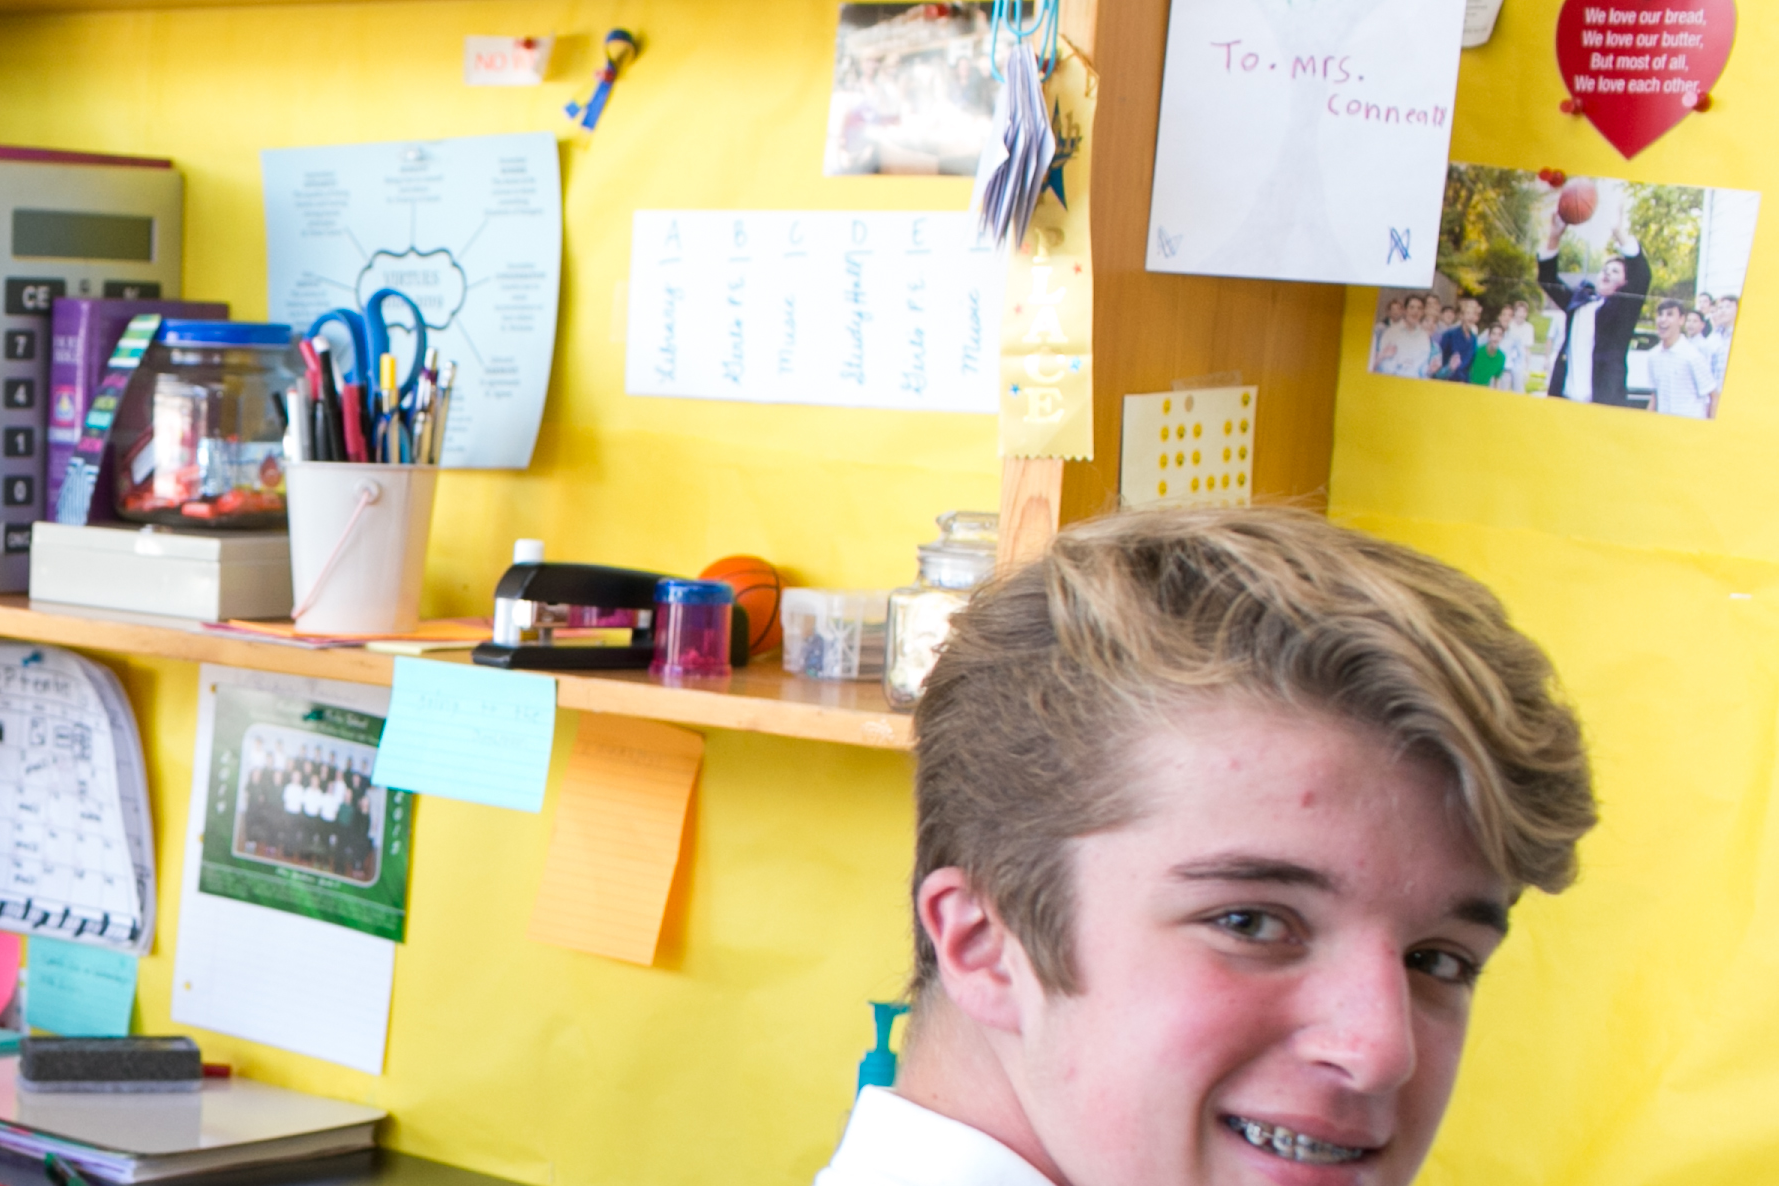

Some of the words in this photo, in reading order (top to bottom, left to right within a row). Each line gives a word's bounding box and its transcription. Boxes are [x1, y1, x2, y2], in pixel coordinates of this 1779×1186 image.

[1584, 7, 1606, 25] We
[1608, 7, 1636, 25] love
[1639, 11, 1662, 25] our
[1665, 8, 1707, 26] bread,
[1581, 30, 1604, 47] We
[1605, 30, 1633, 47] love
[1636, 33, 1660, 47] our
[1661, 31, 1704, 49] butter,
[1590, 52, 1614, 70] But
[1616, 54, 1650, 70] most
[1652, 53, 1667, 70] of
[1669, 54, 1689, 72] all,
[1574, 75, 1596, 93] We
[1597, 75, 1625, 93] love
[1627, 76, 1661, 93] each
[665, 218, 682, 250] A
[733, 218, 748, 248] B
[789, 220, 804, 245] C
[851, 218, 868, 245] D
[912, 217, 927, 246] E
[22, 285, 50, 309] CE
[1022, 226, 1070, 424] PLACE
[14, 335, 27, 357] 7
[14, 384, 27, 405] 4
[15, 432, 26, 454] 1
[13, 480, 27, 503] 0
